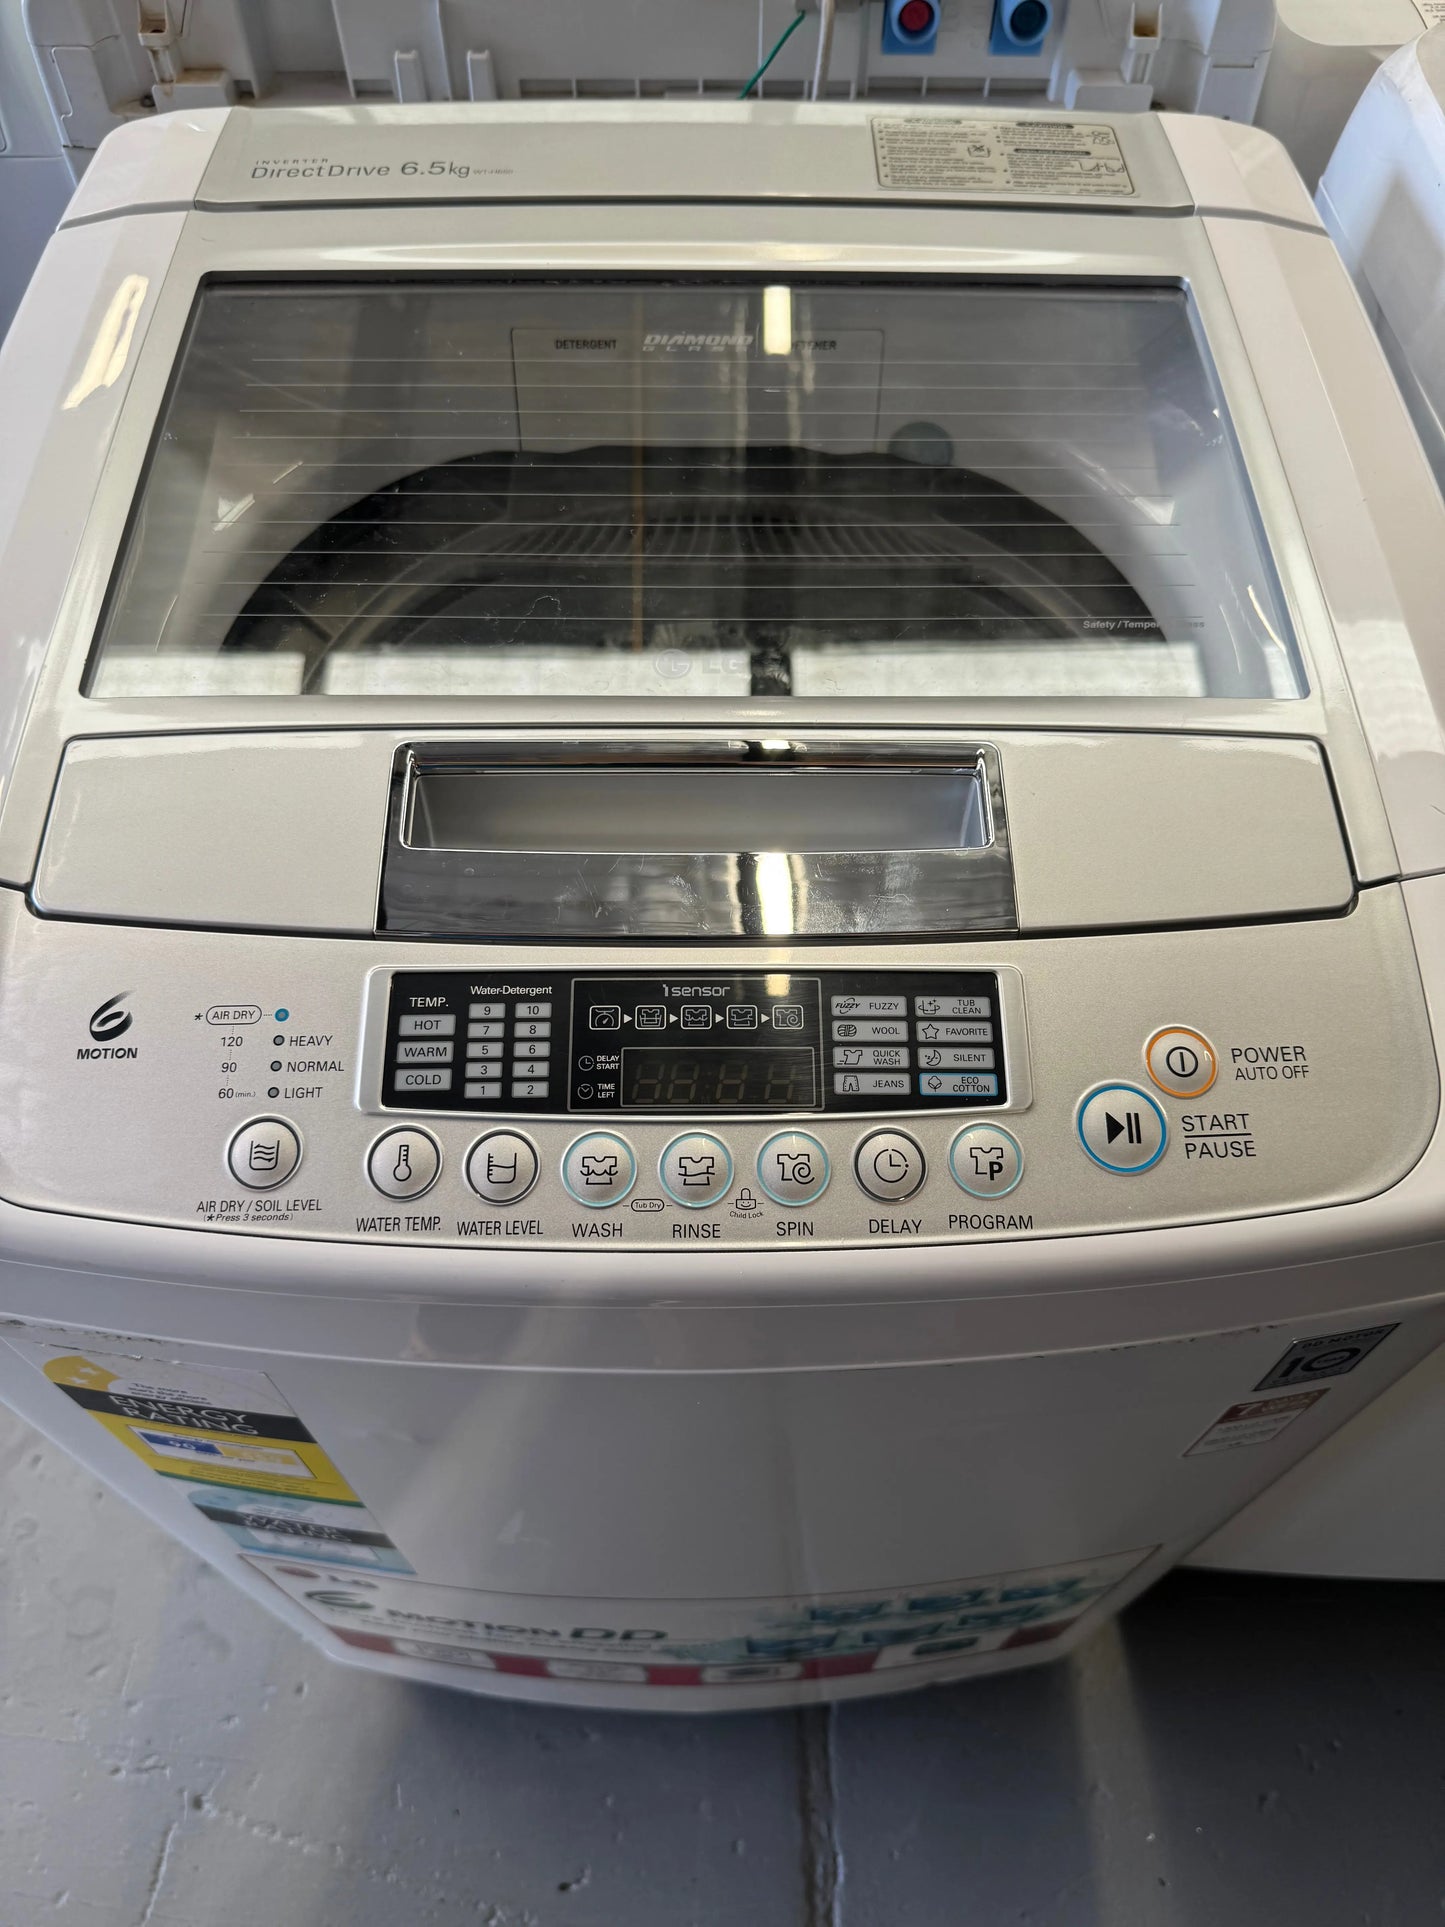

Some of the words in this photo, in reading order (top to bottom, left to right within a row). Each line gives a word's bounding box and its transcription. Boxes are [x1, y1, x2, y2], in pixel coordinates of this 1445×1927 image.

[401, 161, 471, 179] 6.5kg
[643, 331, 754, 346] DIAMOND
[555, 339, 617, 350] DETERGENT
[1083, 620, 1116, 630] Safety
[470, 985, 553, 997] Water-Detergent
[409, 997, 449, 1008] TEMP.
[869, 1002, 900, 1010] FUZZY
[956, 999, 976, 1007] TUB
[211, 1010, 231, 1020] AIR
[233, 1010, 256, 1020] DRY
[483, 1006, 491, 1016] 9
[526, 1005, 540, 1015] 10
[952, 1007, 982, 1015] CLEAN
[413, 1019, 442, 1031] HOT
[482, 1025, 490, 1035] 7
[529, 1024, 537, 1035] 8
[871, 1027, 901, 1035] WOOL
[945, 1027, 988, 1036] FAVORITE
[220, 1036, 243, 1047] 120
[289, 1035, 333, 1047] HEAVY
[76, 1047, 138, 1060] MOTION
[404, 1046, 448, 1058] WARM
[481, 1045, 489, 1055] 5
[528, 1044, 536, 1054] 6
[872, 1049, 901, 1058] QUICK
[1231, 1045, 1307, 1064] POWER
[873, 1057, 901, 1065] WASH
[953, 1053, 987, 1062] SILENT
[221, 1062, 237, 1073] 90
[286, 1060, 345, 1073] NORMAL
[480, 1065, 488, 1075] 3
[527, 1064, 535, 1074] 4
[596, 1062, 620, 1070] START
[1234, 1065, 1278, 1081] AUTO
[1281, 1065, 1310, 1080] OFF
[405, 1074, 442, 1085] COLD
[872, 1080, 905, 1089] JEANS
[961, 1076, 979, 1084] ECO
[284, 1086, 323, 1099] LIGHT
[480, 1085, 486, 1095] 1
[527, 1084, 535, 1095] 2
[952, 1084, 990, 1093] COTTON
[1181, 1113, 1250, 1132] START
[1185, 1140, 1257, 1159] PAUSE
[196, 1201, 218, 1212] AIR
[219, 1201, 246, 1212] DRY
[254, 1200, 283, 1212] SOIL
[285, 1199, 323, 1211] LEVEL
[634, 1201, 648, 1209] Tub
[649, 1201, 662, 1210] Dry
[243, 1213, 249, 1221] 3
[729, 1210, 747, 1219] Child
[748, 1211, 764, 1219] Lock
[356, 1217, 401, 1233] WATER
[405, 1216, 441, 1231] TEMP.
[868, 1219, 923, 1234] DELAY
[948, 1214, 1034, 1230] PROGRAM
[456, 1221, 502, 1236] WATER
[505, 1220, 544, 1235] LEVEL
[572, 1223, 623, 1238] WASH
[672, 1223, 721, 1239] RINSE
[776, 1221, 814, 1237] SPIN
[108, 1395, 248, 1424] ENERGY
[122, 1406, 259, 1435] RATING
[570, 1626, 668, 1641] DD
